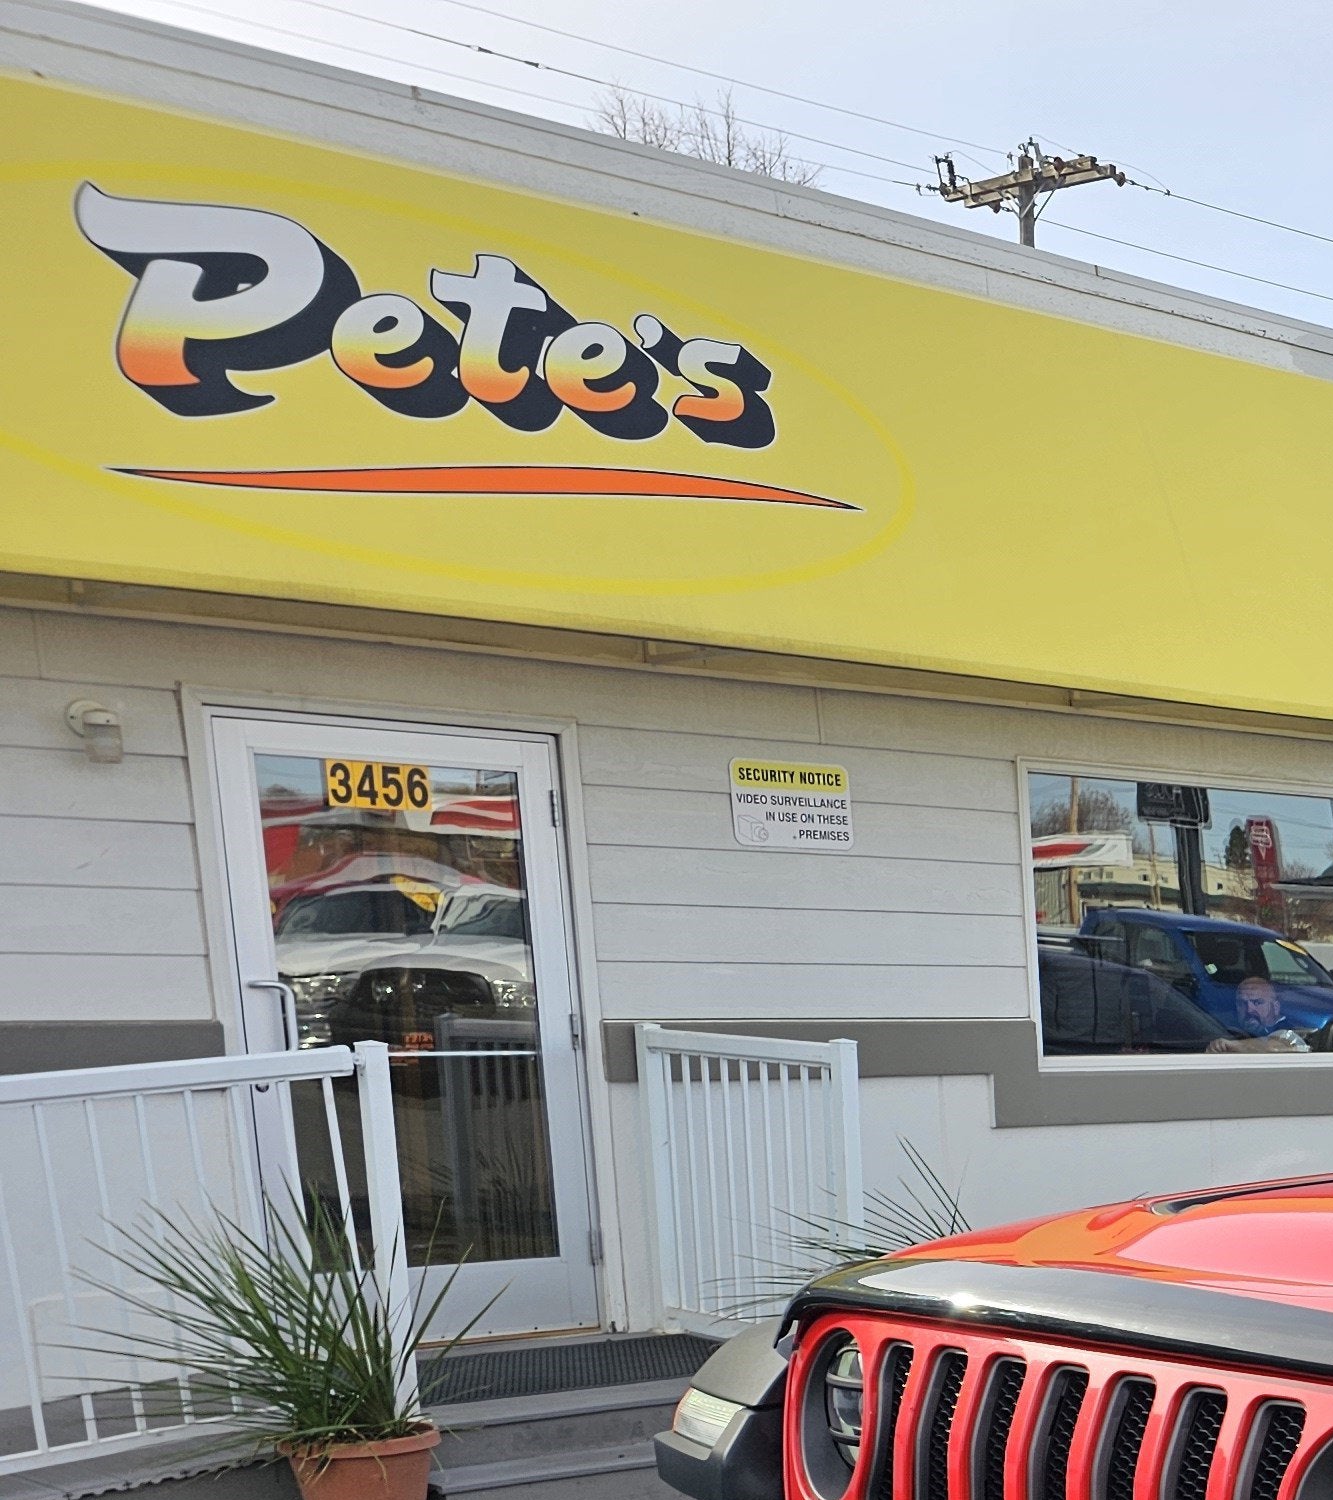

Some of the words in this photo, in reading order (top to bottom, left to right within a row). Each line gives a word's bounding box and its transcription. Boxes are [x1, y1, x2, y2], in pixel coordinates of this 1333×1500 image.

[74, 180, 776, 449] Pete's
[329, 762, 429, 809] 3456
[738, 766, 796, 784] SECURITY
[799, 771, 842, 787] NOTICE
[735, 793, 768, 805] VIDEO
[770, 795, 848, 810] SURVEILLANCE
[765, 811, 776, 822] IN
[778, 812, 798, 823] USE
[800, 813, 815, 824] ON
[817, 814, 849, 826] THESE
[799, 829, 850, 842] PREMISES
